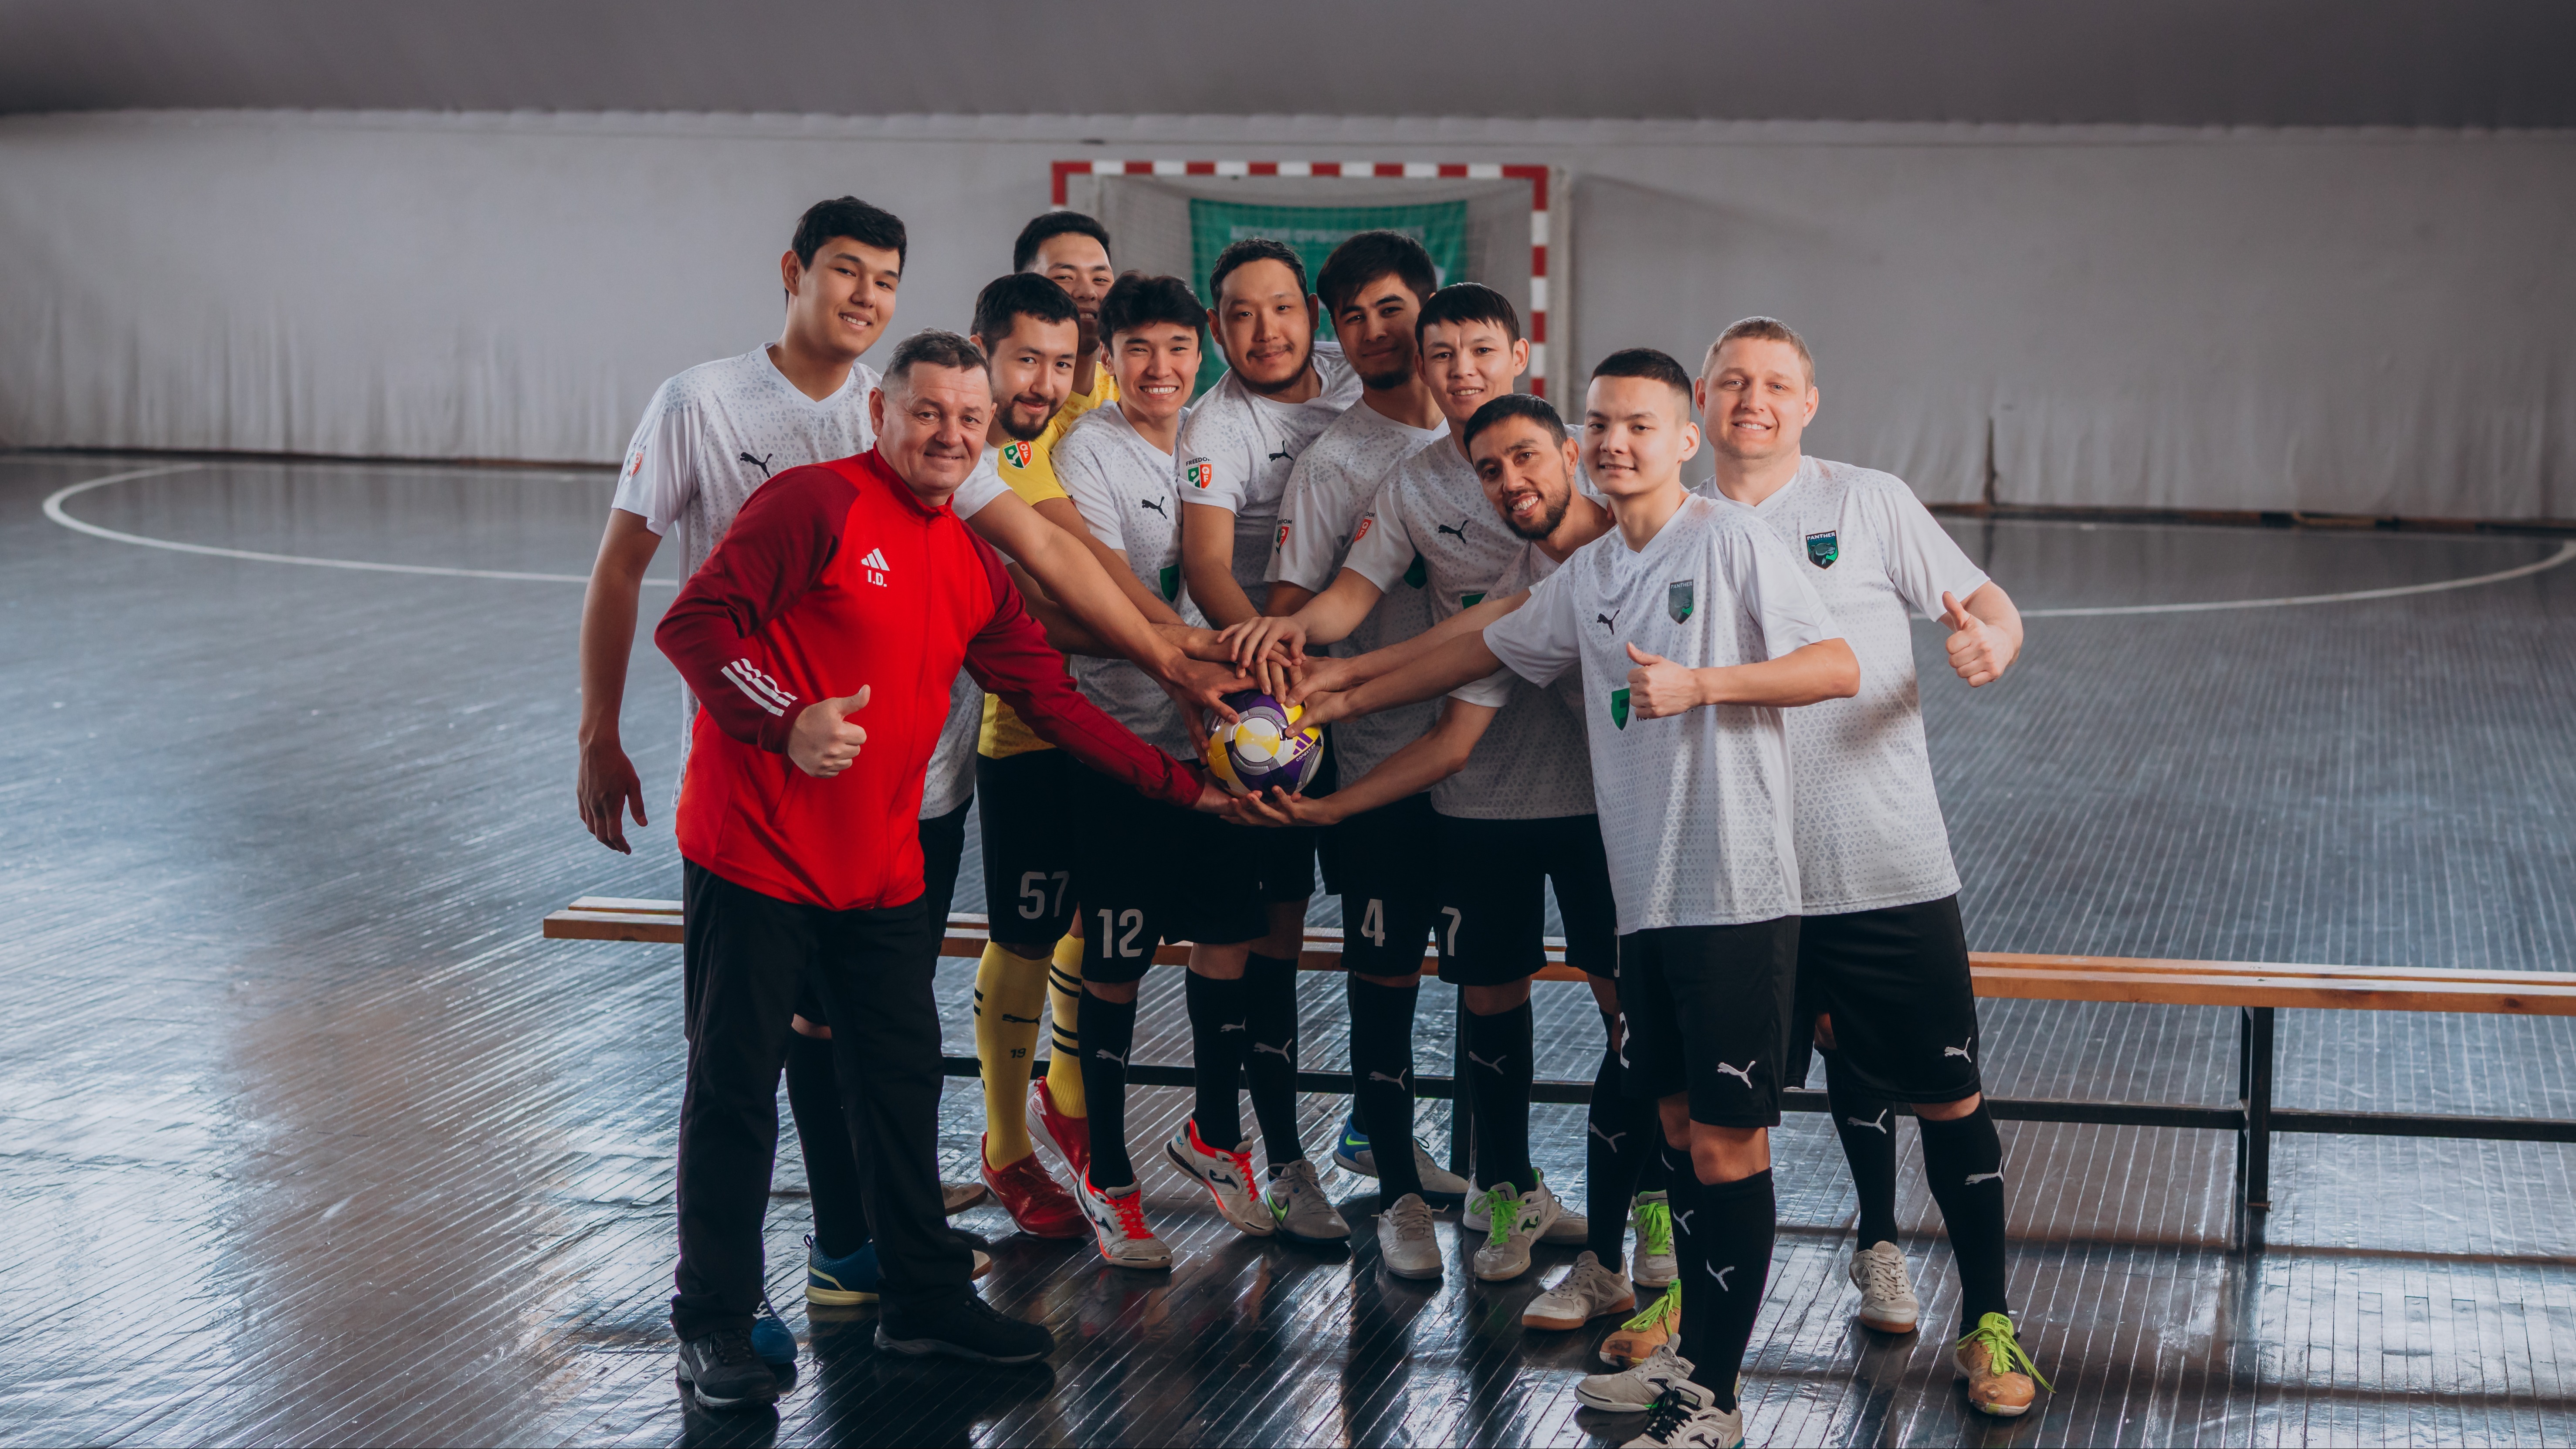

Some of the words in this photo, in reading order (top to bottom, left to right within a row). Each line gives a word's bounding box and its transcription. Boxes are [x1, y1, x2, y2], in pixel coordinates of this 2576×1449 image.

[1186, 457, 1213, 466] FREEDO
[1201, 466, 1210, 482] QF
[1807, 532, 1835, 541] PANTHER
[868, 569, 887, 587] I.D.
[1018, 870, 1070, 920] 57
[1361, 898, 1385, 947] 4
[1437, 906, 1462, 957] 7
[1097, 908, 1144, 958] 12
[1010, 1048, 1026, 1059] 19
